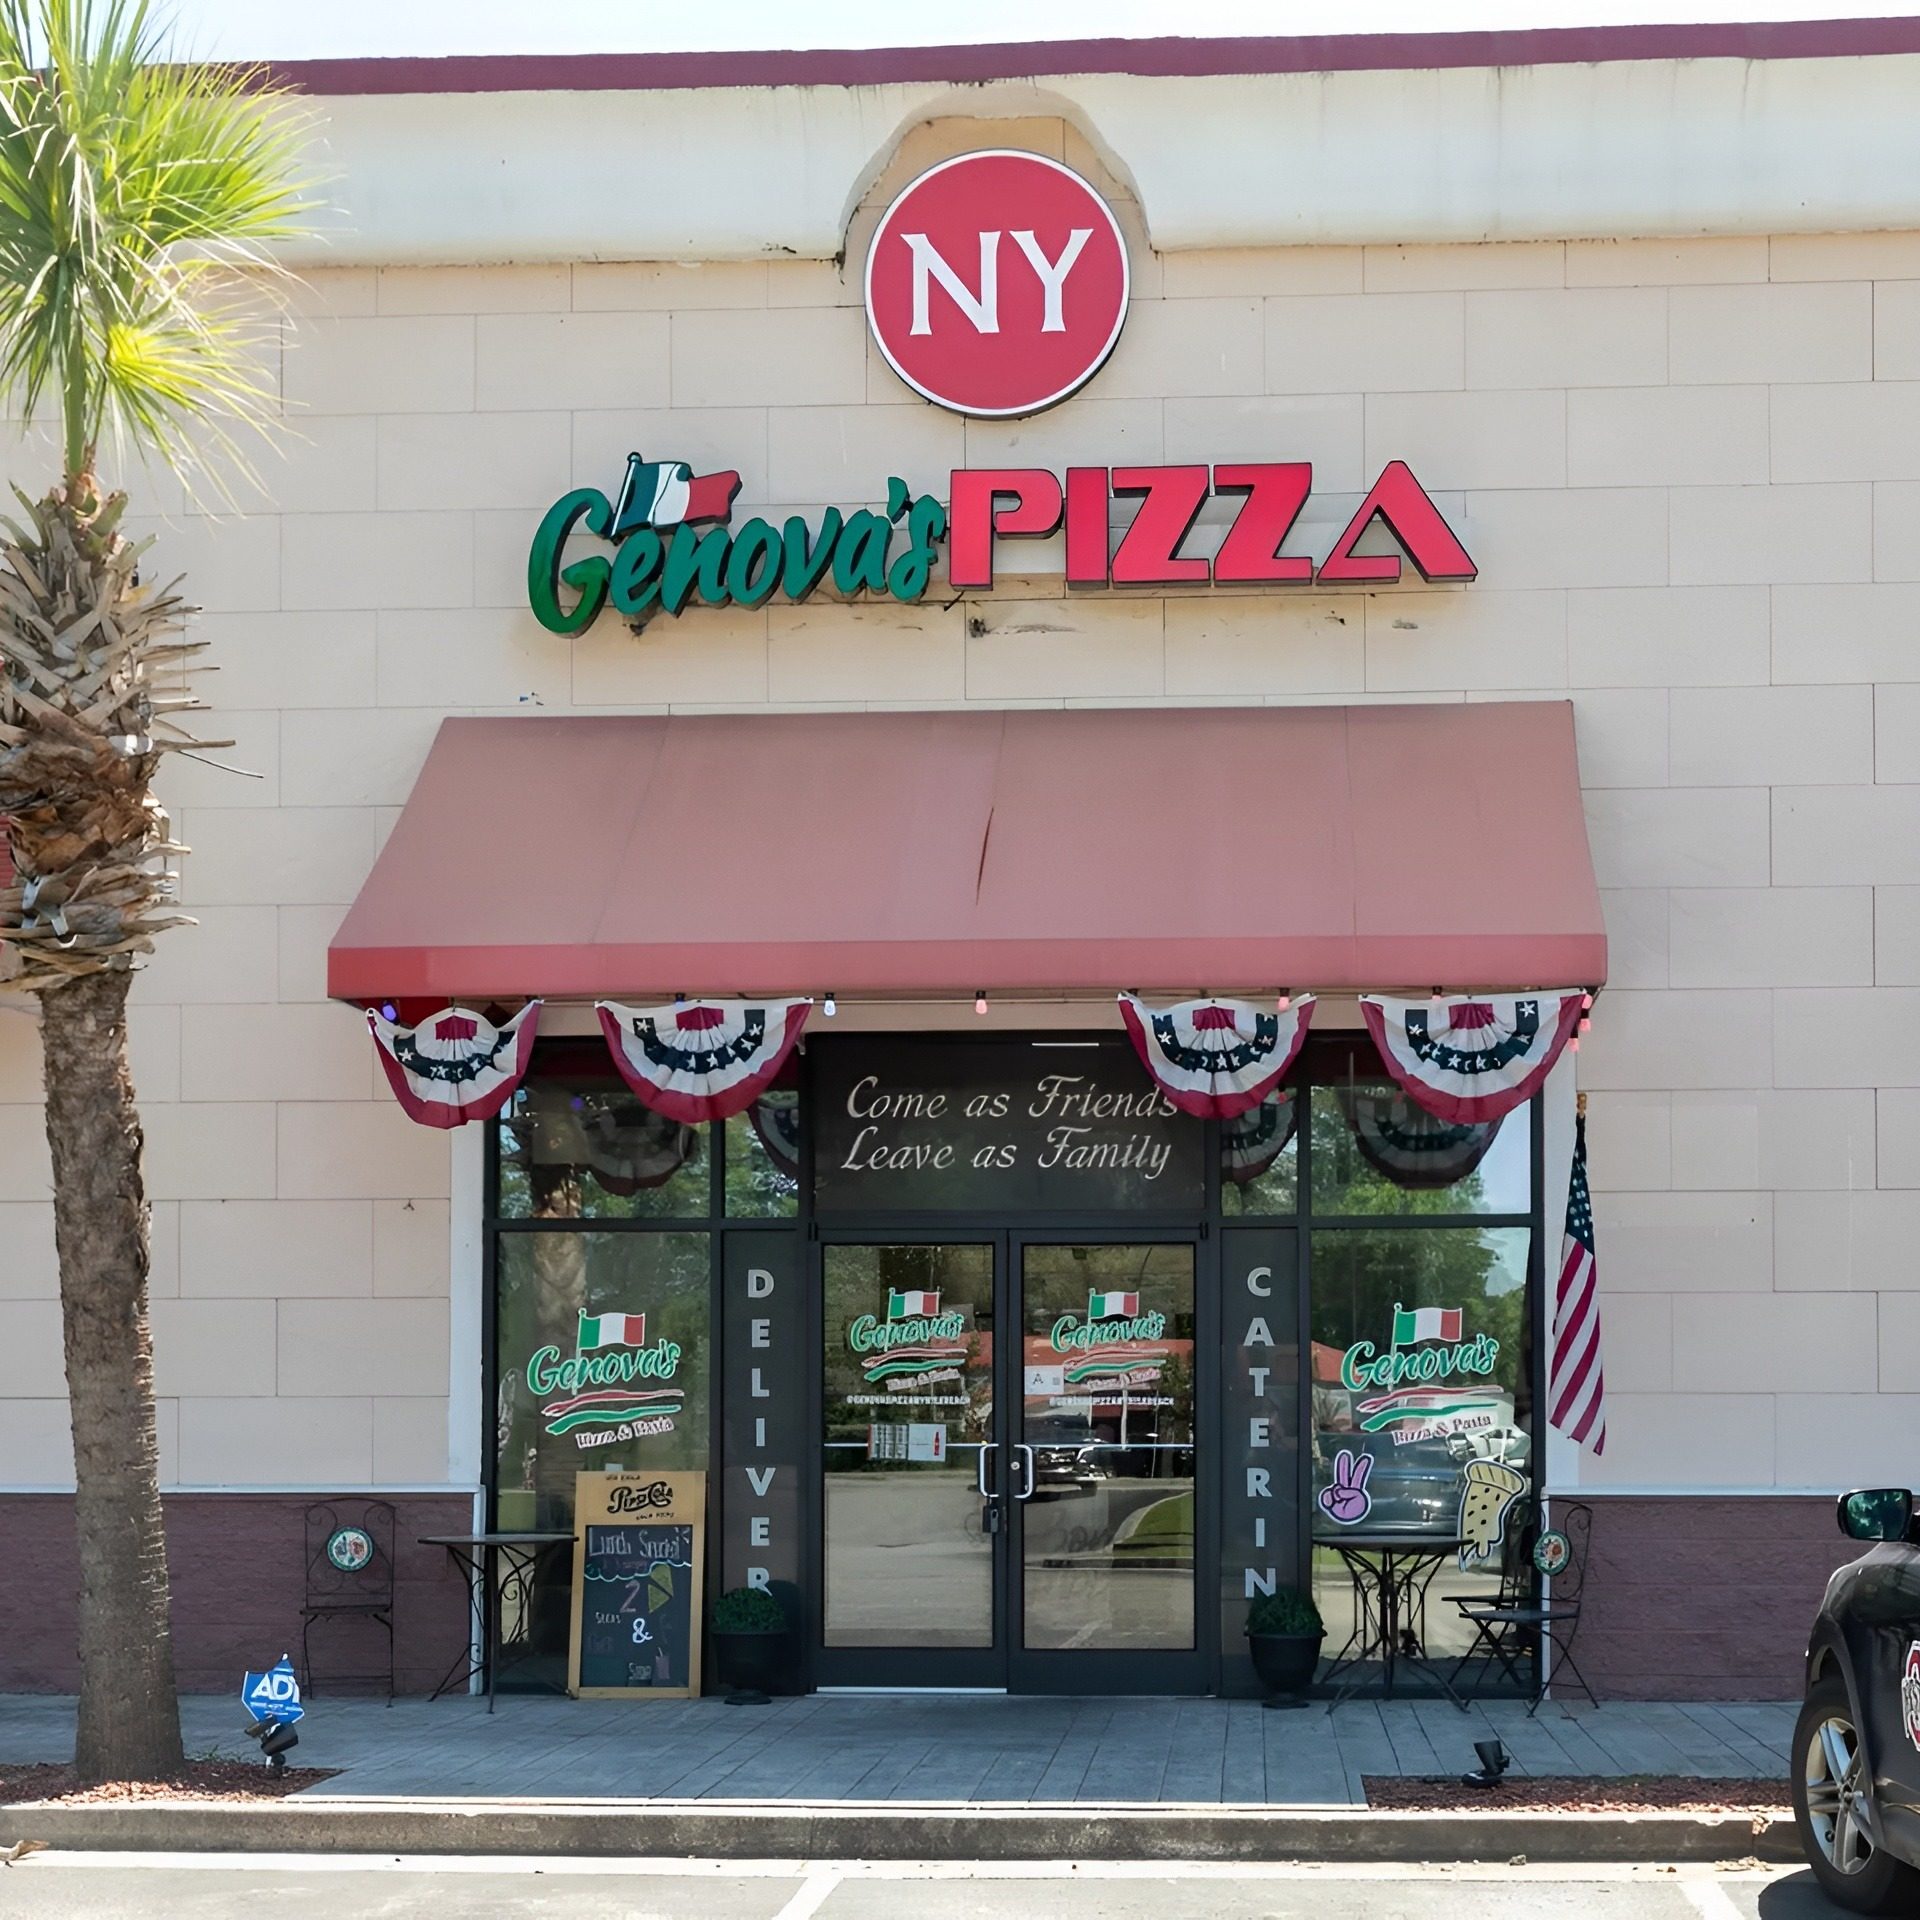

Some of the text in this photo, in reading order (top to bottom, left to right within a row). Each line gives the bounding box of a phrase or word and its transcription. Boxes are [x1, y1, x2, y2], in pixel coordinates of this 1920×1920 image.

[900, 228, 1094, 336] NY
[529, 459, 1477, 636] Genova's PIZZA
[846, 1075, 1178, 1119] Come as Friends
[841, 1126, 1172, 1180] Leave as Family
[527, 1338, 681, 1396] Genova's
[1340, 1333, 1499, 1392] Genova's
[620, 1579, 641, 1613] 2
[632, 1617, 653, 1643] &
